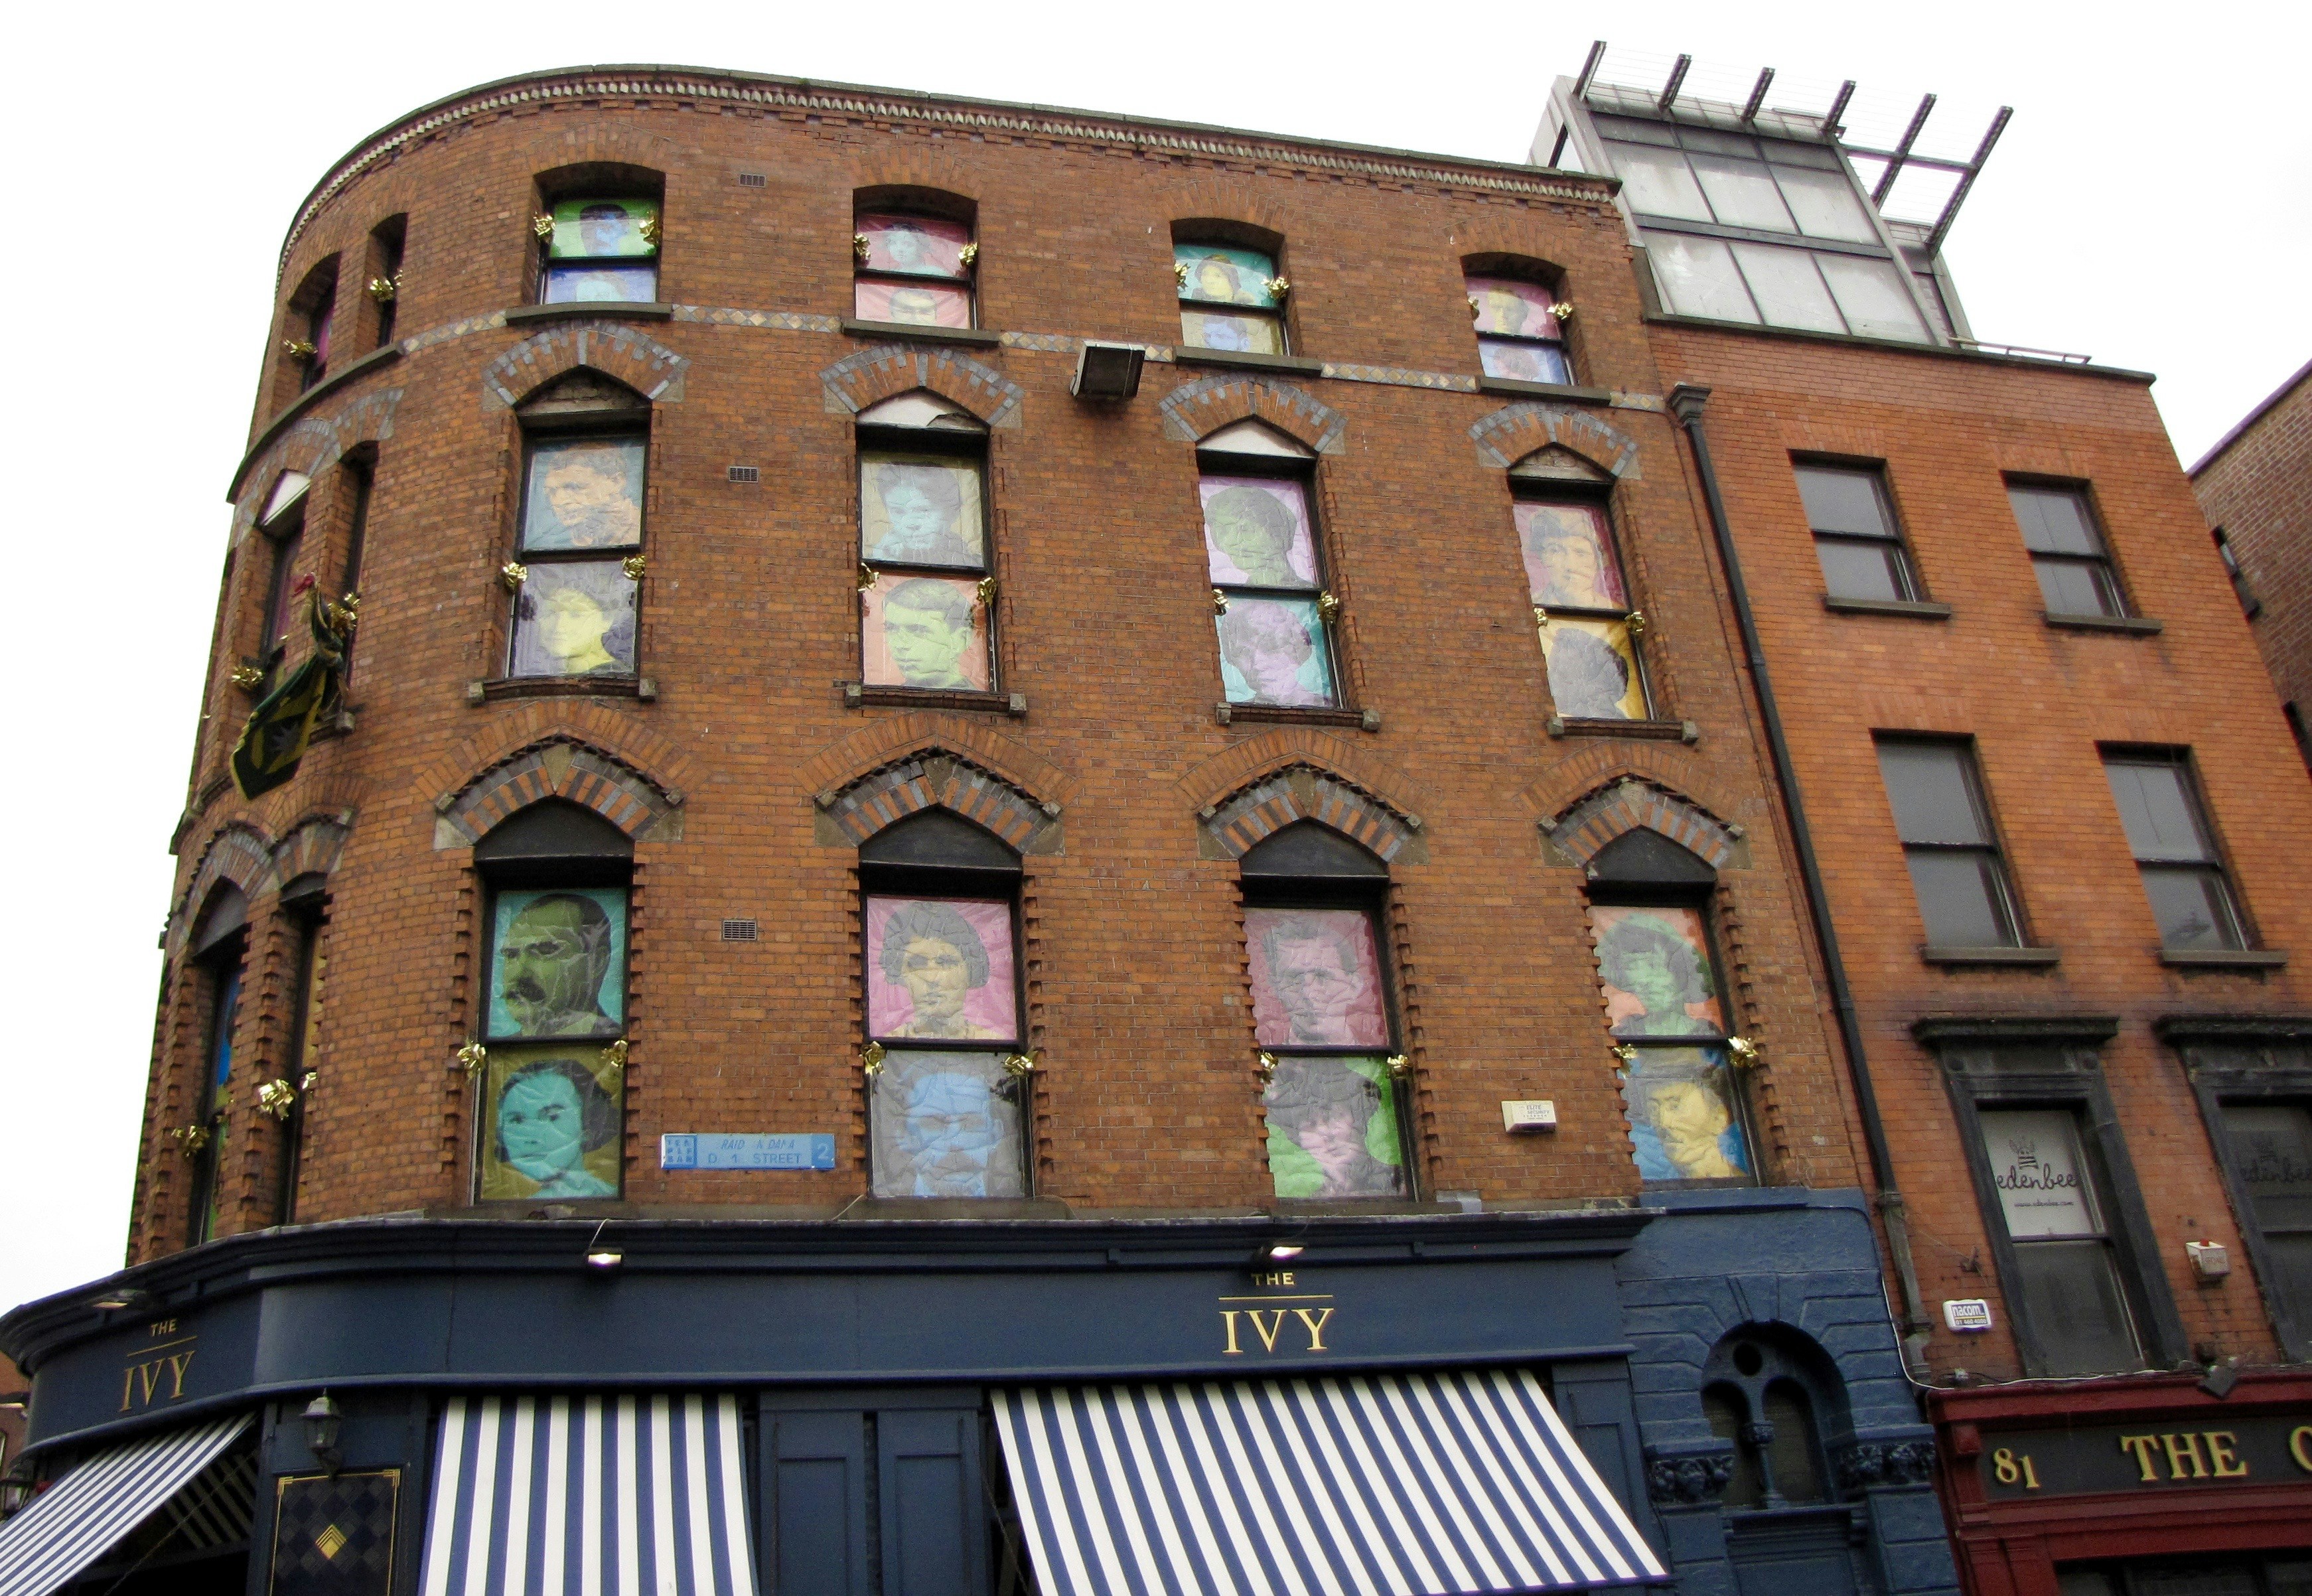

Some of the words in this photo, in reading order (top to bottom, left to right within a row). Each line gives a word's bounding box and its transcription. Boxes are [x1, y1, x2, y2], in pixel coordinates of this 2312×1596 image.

[753, 1153, 802, 1164] STREET
[818, 1143, 829, 1159] 2
[1996, 1163, 2077, 1189] edenbee
[1251, 1272, 1295, 1285] THE
[151, 1318, 177, 1337] THE
[1219, 1308, 1334, 1353] IVY
[119, 1350, 195, 1412] IVY
[1993, 1448, 2041, 1489] 81
[2121, 1431, 2248, 1482] THE
